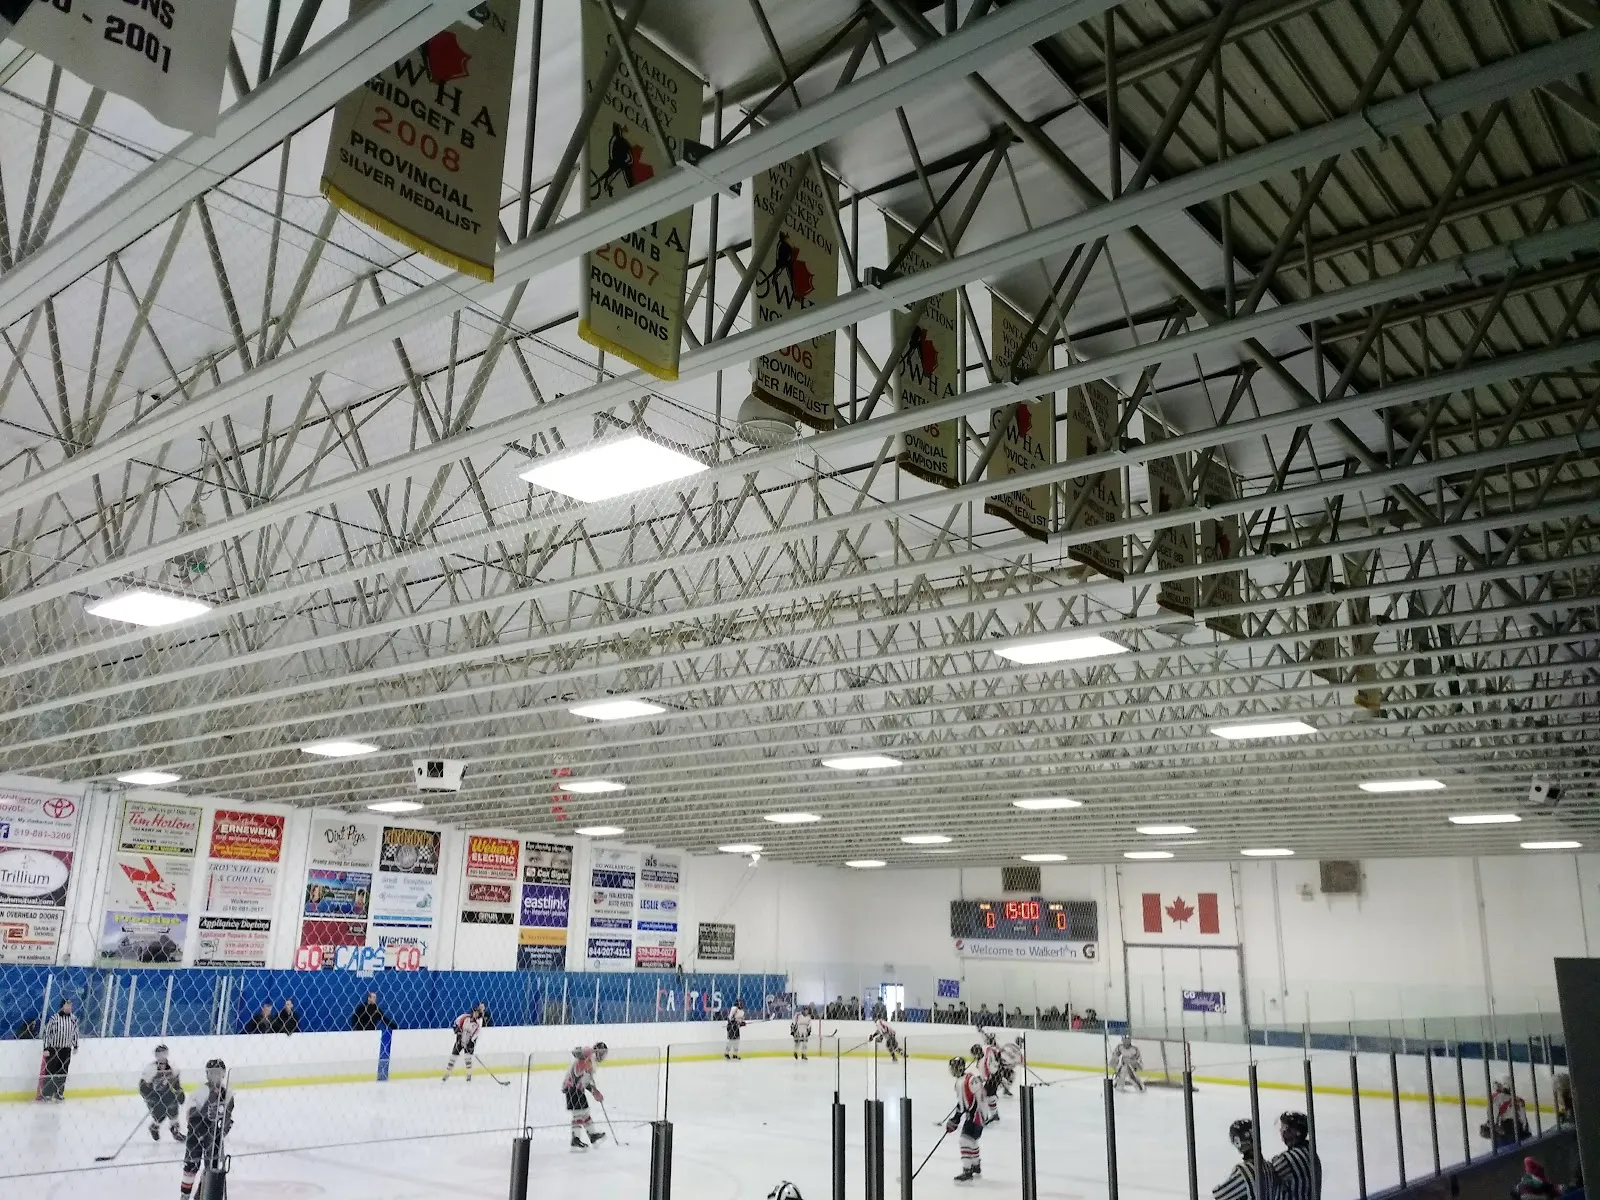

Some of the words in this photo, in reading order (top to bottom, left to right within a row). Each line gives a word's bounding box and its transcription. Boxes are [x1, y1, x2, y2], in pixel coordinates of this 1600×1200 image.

[104, 14, 172, 74] 2001
[364, 76, 455, 136] MIDGET
[460, 127, 476, 150] B
[372, 105, 461, 173] 2008
[350, 129, 474, 213] PROVINCIAL
[339, 147, 396, 191] SILVER
[399, 183, 482, 236] MEDALIST
[753, 193, 833, 256] ASSCIATION
[595, 243, 660, 287] 2007
[591, 264, 670, 321] ROVINCIAL
[590, 286, 670, 341] HAMPIONS
[905, 433, 948, 460] OVINCIAL
[907, 450, 949, 474] AMPIONS
[129, 811, 150, 827] Tim
[152, 813, 195, 831] Hortons
[220, 823, 277, 838] ERNEWEIN
[324, 825, 346, 844] Dirt
[471, 852, 515, 864] ELECTRIC
[0, 869, 50, 885] Trillium
[524, 894, 567, 910] eastlink
[640, 899, 659, 910] LESLIE
[1004, 901, 1040, 920] 15:00
[6, 911, 38, 920] OVERHEAD
[201, 919, 239, 930] Appliance
[241, 921, 271, 930] Doctors
[295, 944, 323, 971] GO
[334, 945, 386, 971] CAPS
[397, 946, 421, 971] GO
[970, 944, 1013, 956] Welcome
[1016, 945, 1026, 956] to
